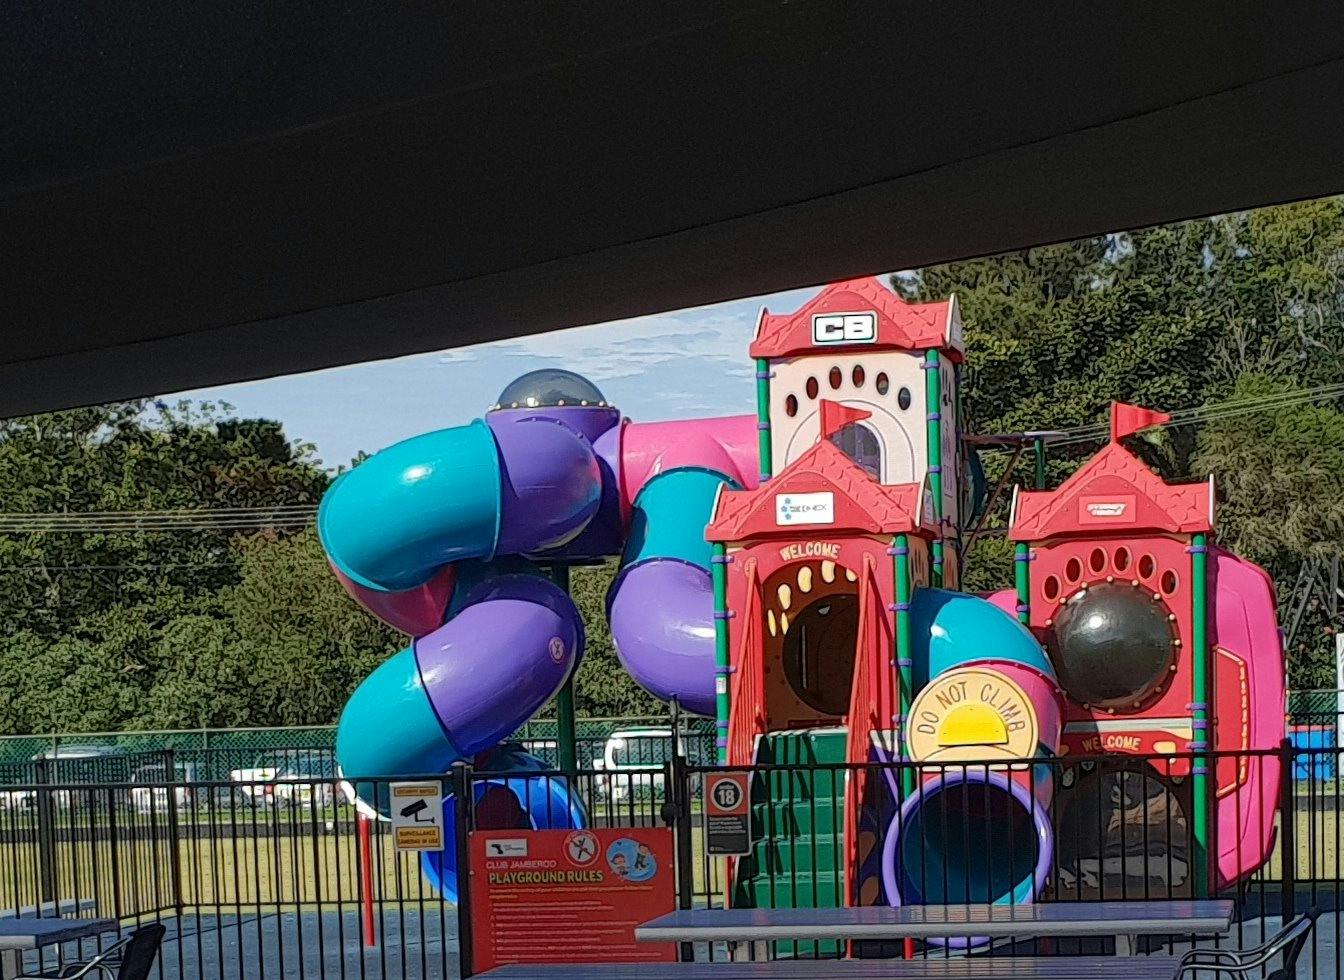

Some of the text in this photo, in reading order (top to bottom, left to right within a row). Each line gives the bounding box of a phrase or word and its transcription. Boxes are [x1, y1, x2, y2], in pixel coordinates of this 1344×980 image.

[815, 315, 874, 341] CB
[780, 541, 841, 561] WELCOME
[917, 682, 1026, 734] DO NOT CLIMB
[1082, 735, 1142, 751] WELCOME
[719, 789, 735, 805] 18
[486, 861, 508, 869] CLUB
[489, 870, 603, 884] PLAYGROUND RULES
